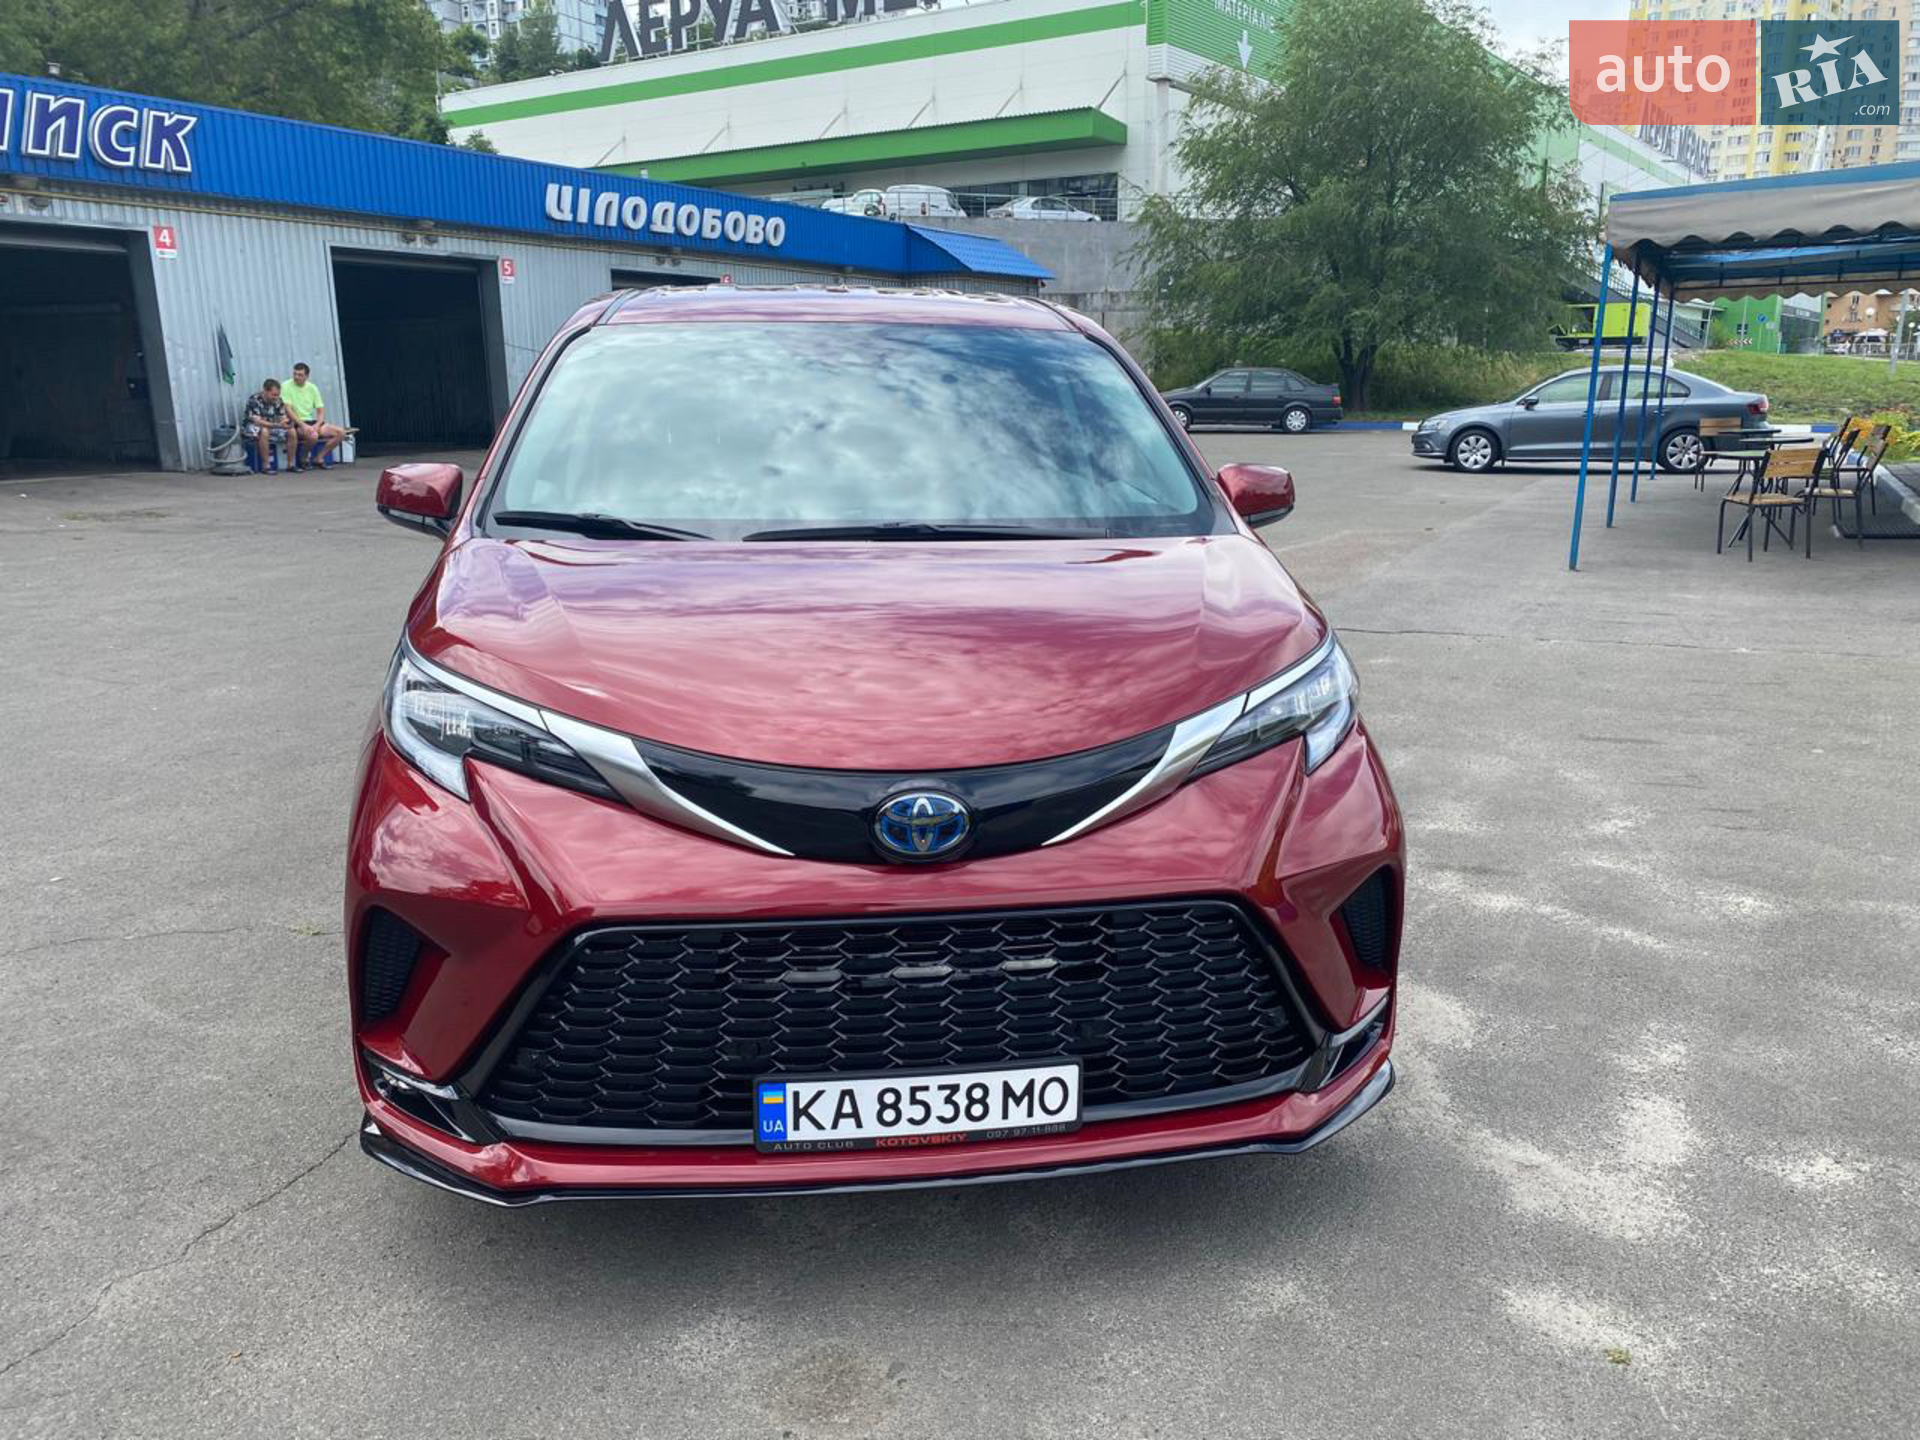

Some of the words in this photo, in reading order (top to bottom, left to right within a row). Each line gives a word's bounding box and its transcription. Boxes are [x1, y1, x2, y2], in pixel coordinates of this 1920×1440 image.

[545, 183, 786, 247] ЦІЛОДОБОВО
[159, 229, 171, 247] 4
[503, 260, 511, 275] 5
[792, 1088, 863, 1131] KA
[876, 1082, 990, 1127] 8538
[1001, 1076, 1069, 1120] MO
[763, 1119, 785, 1134] UA
[774, 1142, 812, 1151] AUTO
[817, 1141, 854, 1149] CLUB
[876, 1133, 967, 1147] KOTOVSKIY
